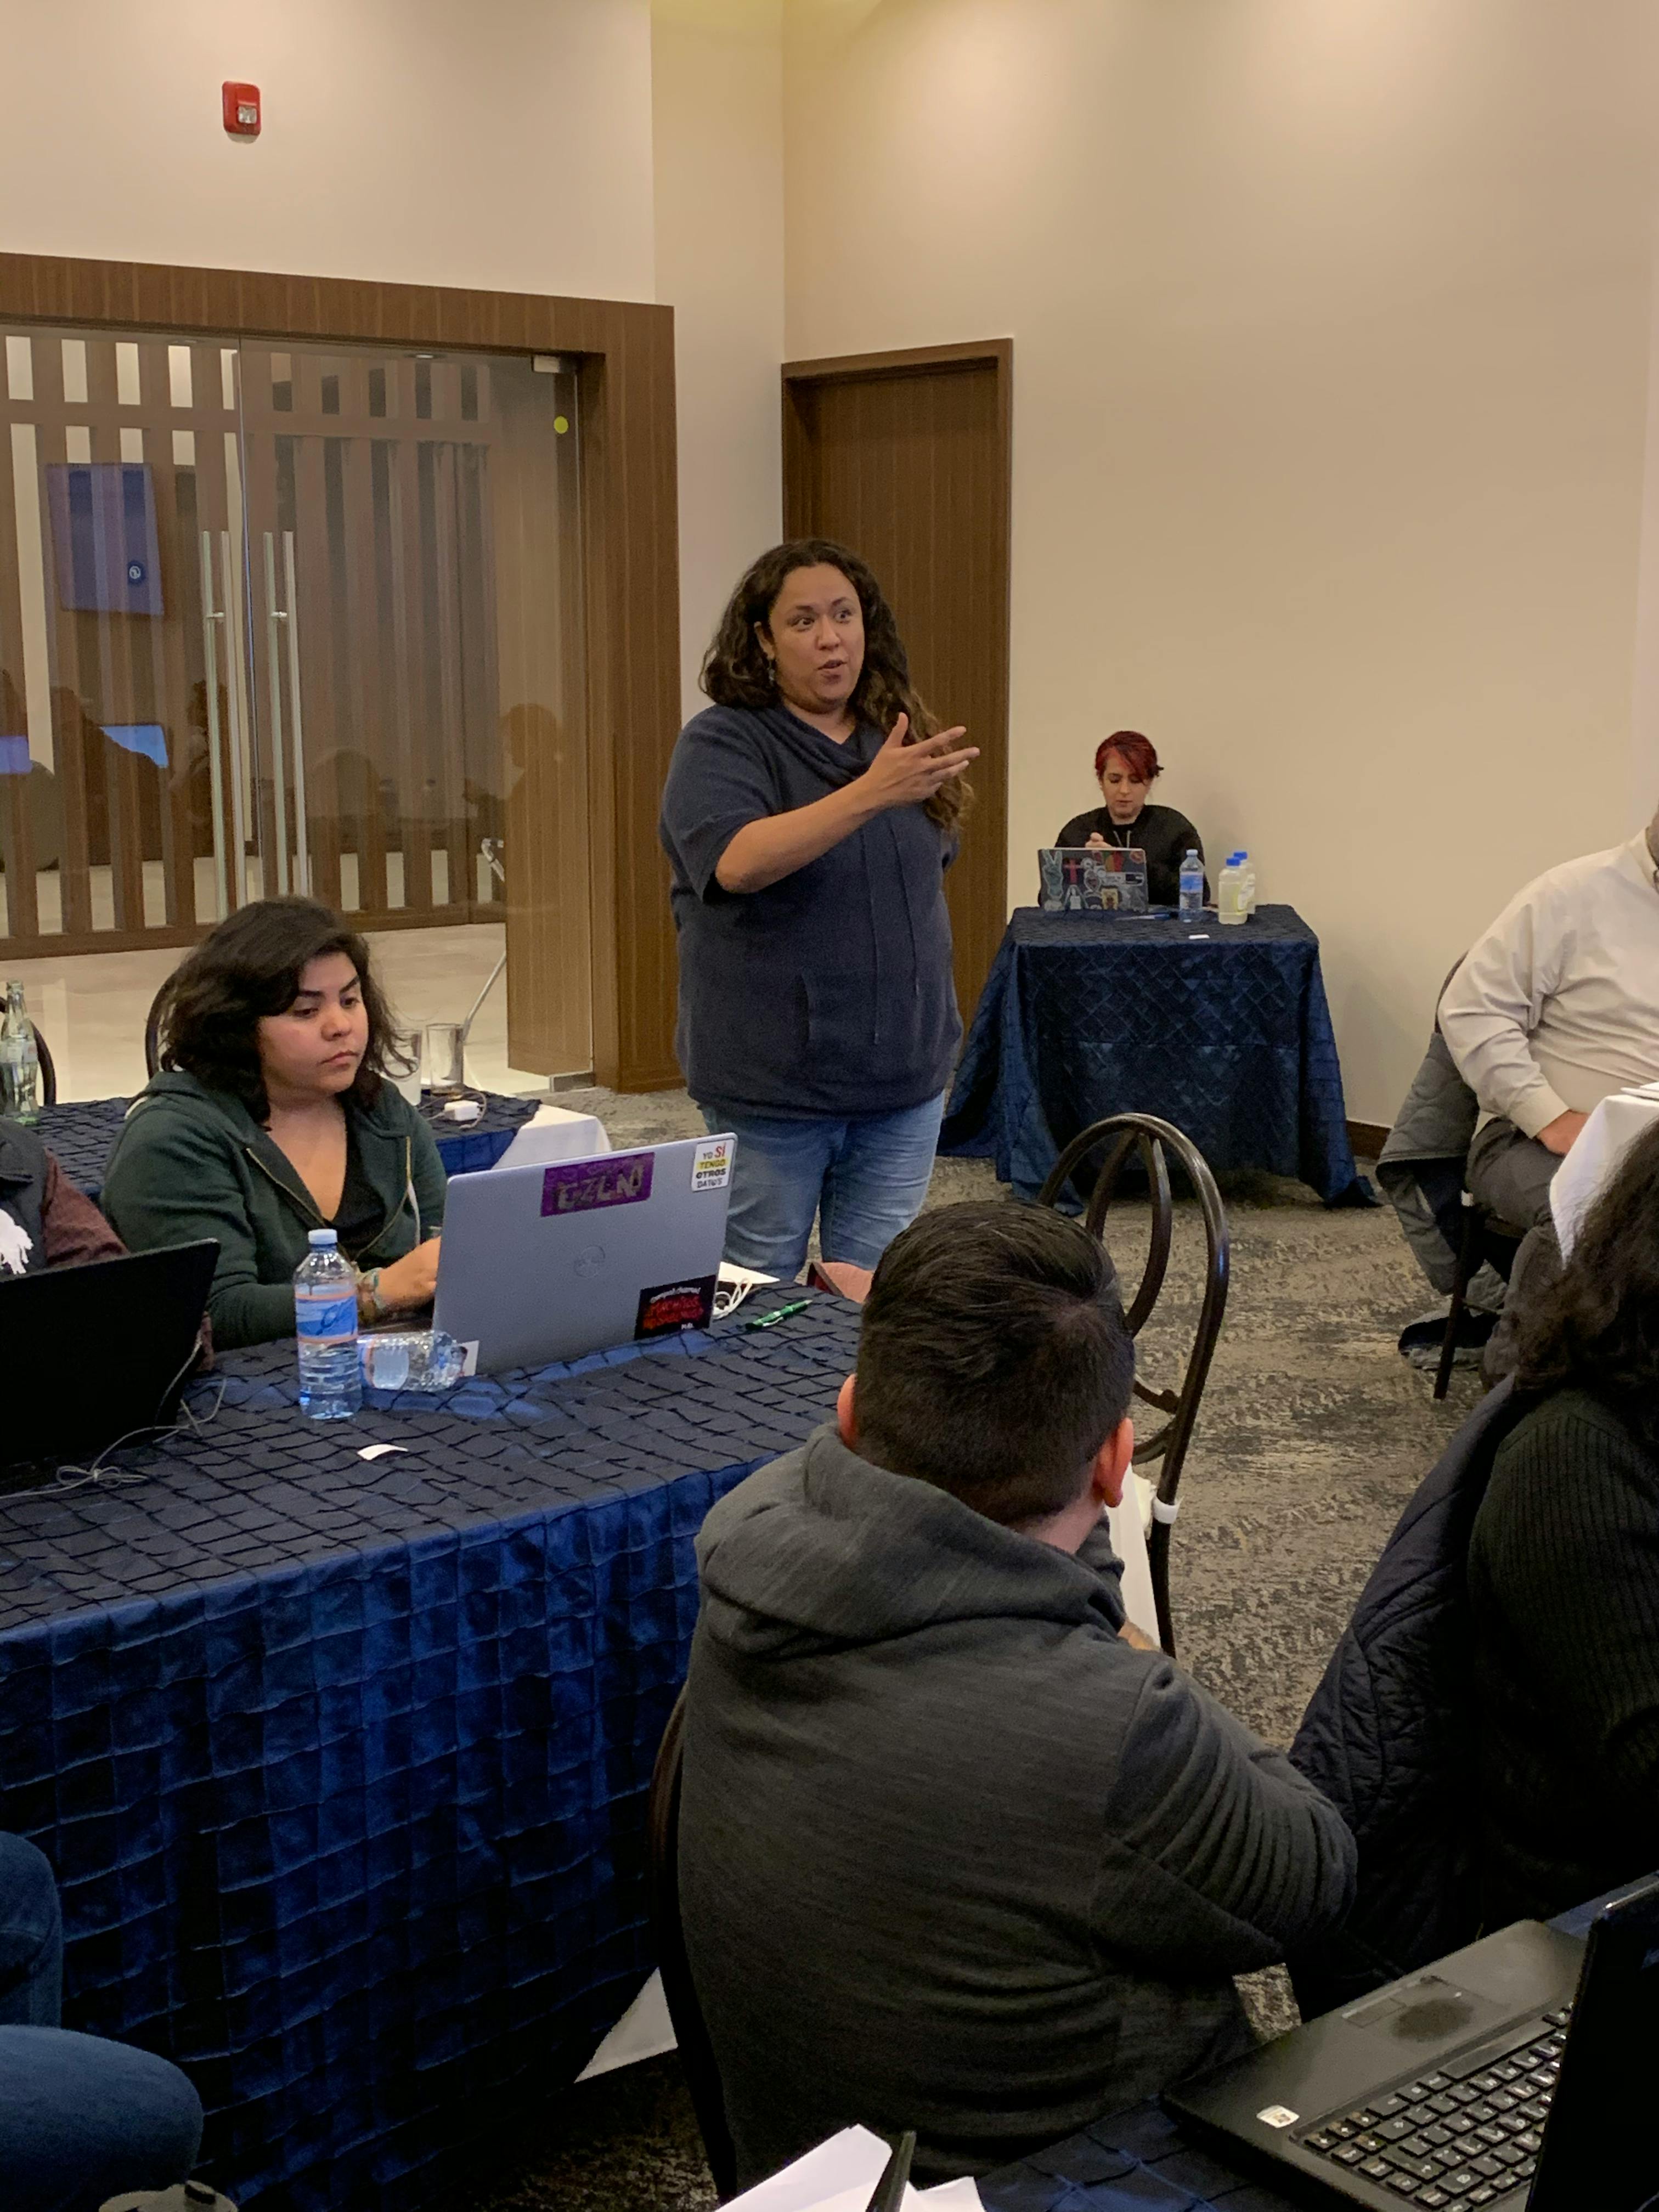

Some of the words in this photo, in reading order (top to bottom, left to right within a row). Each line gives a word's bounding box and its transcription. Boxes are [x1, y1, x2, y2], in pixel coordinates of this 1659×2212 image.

[699, 1159, 726, 1170] TENGO
[696, 1168, 726, 1179] OTROS
[557, 1163, 644, 1210] EZLN
[697, 1177, 723, 1188] DATOS
